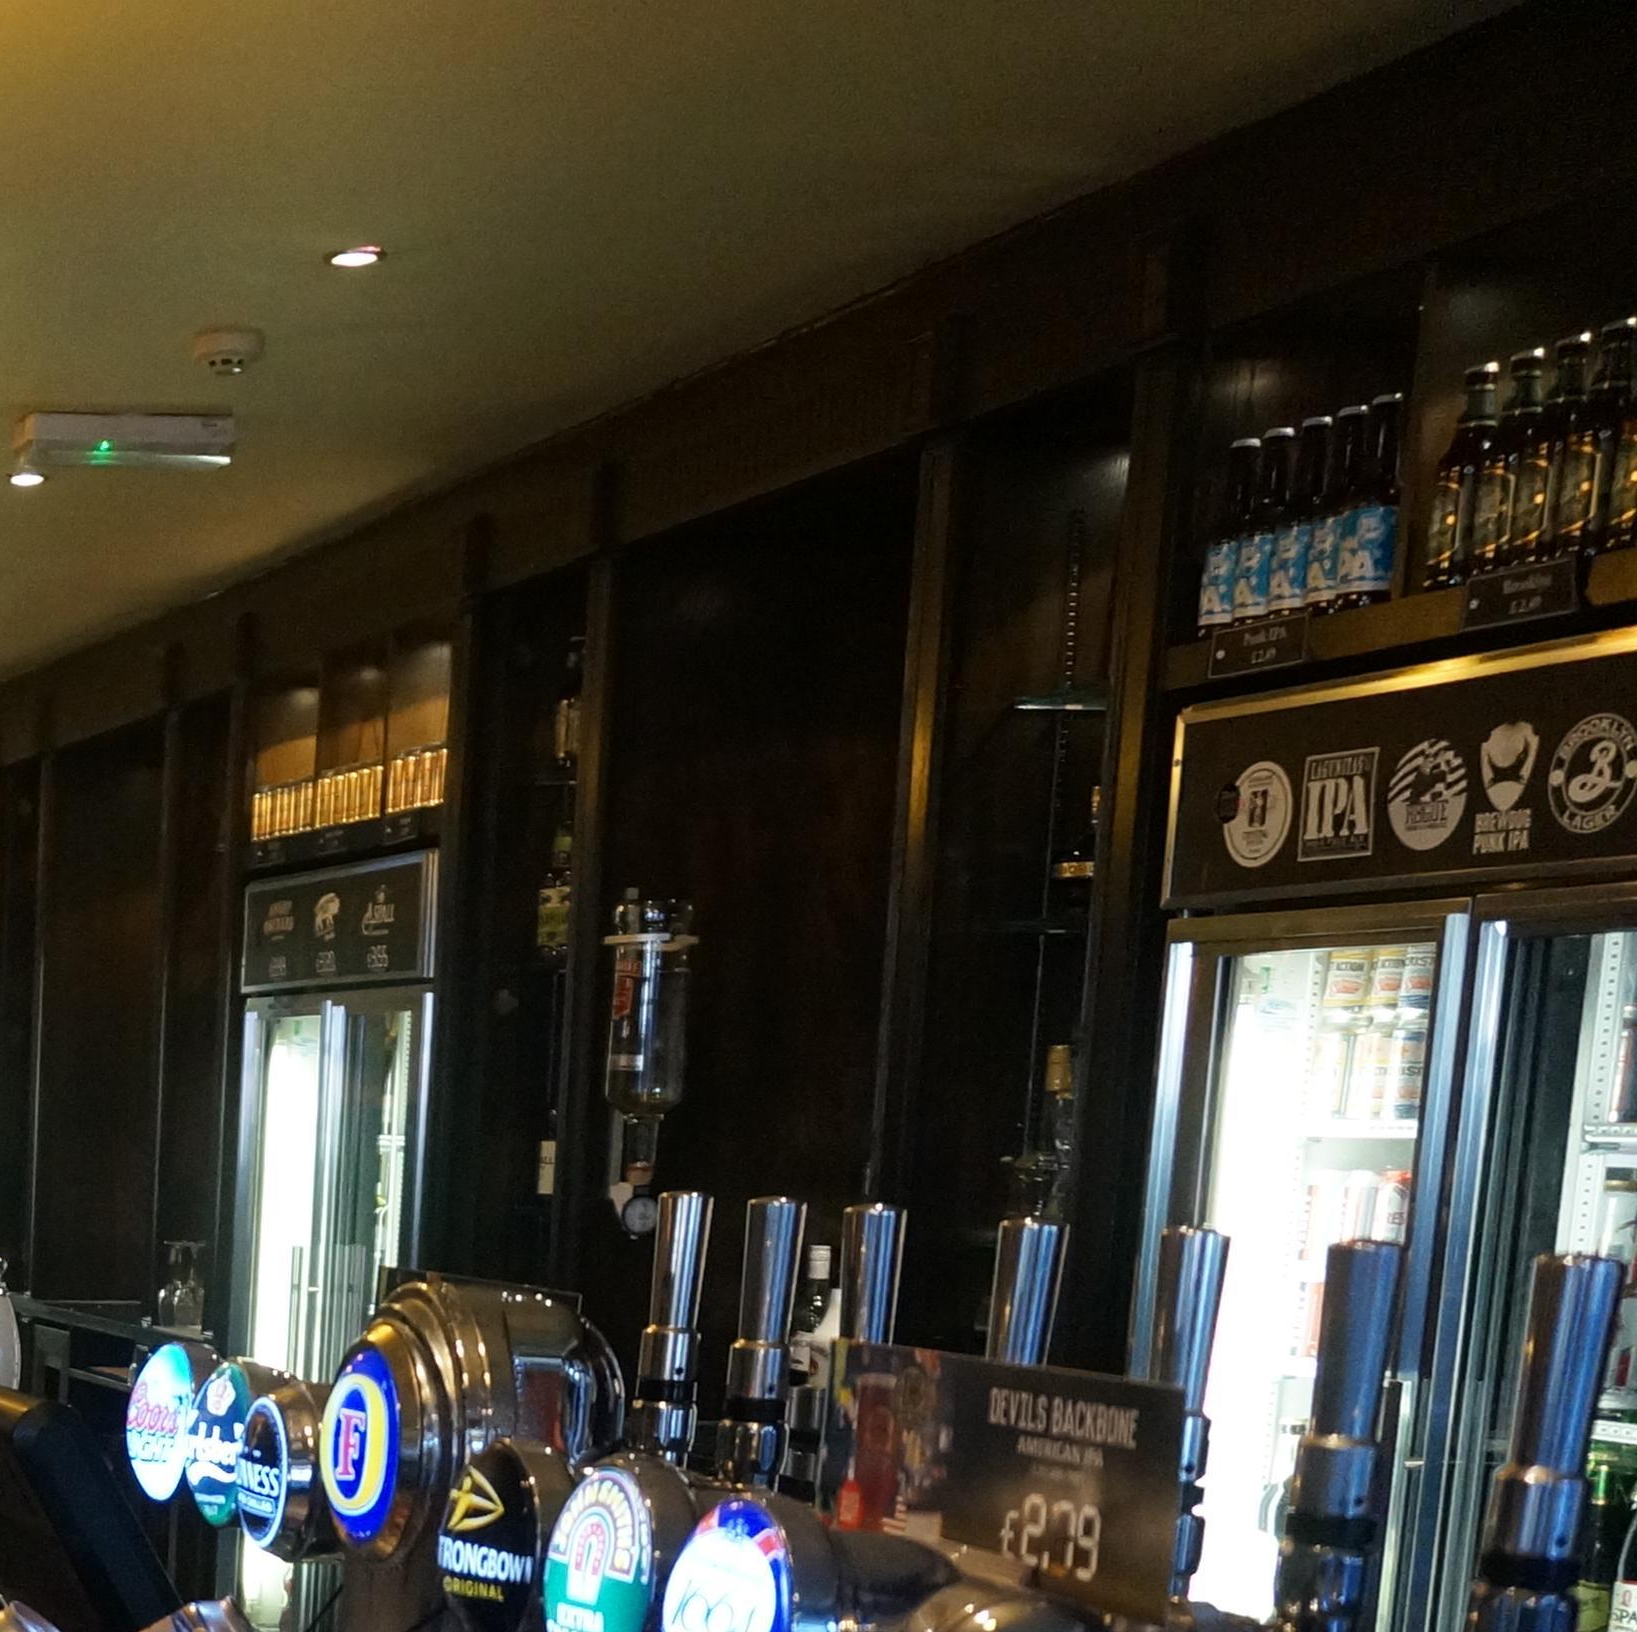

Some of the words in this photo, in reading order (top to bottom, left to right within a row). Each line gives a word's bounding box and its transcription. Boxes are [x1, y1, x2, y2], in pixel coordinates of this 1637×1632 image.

[1303, 776, 1369, 840] IPA
[1562, 805, 1616, 830] LAGER
[1507, 829, 1531, 850] IPA
[988, 1387, 1049, 1431] DEVILS
[1050, 1397, 1140, 1450] BACKBONE
[336, 1409, 366, 1481] F
[1017, 1435, 1080, 1465] AMERICAN
[1000, 1493, 1102, 1583] £2.79
[438, 1535, 524, 1585] TRONGBOW
[443, 1575, 504, 1602] ORIGINAL
[556, 1603, 605, 1632] EXTRA
